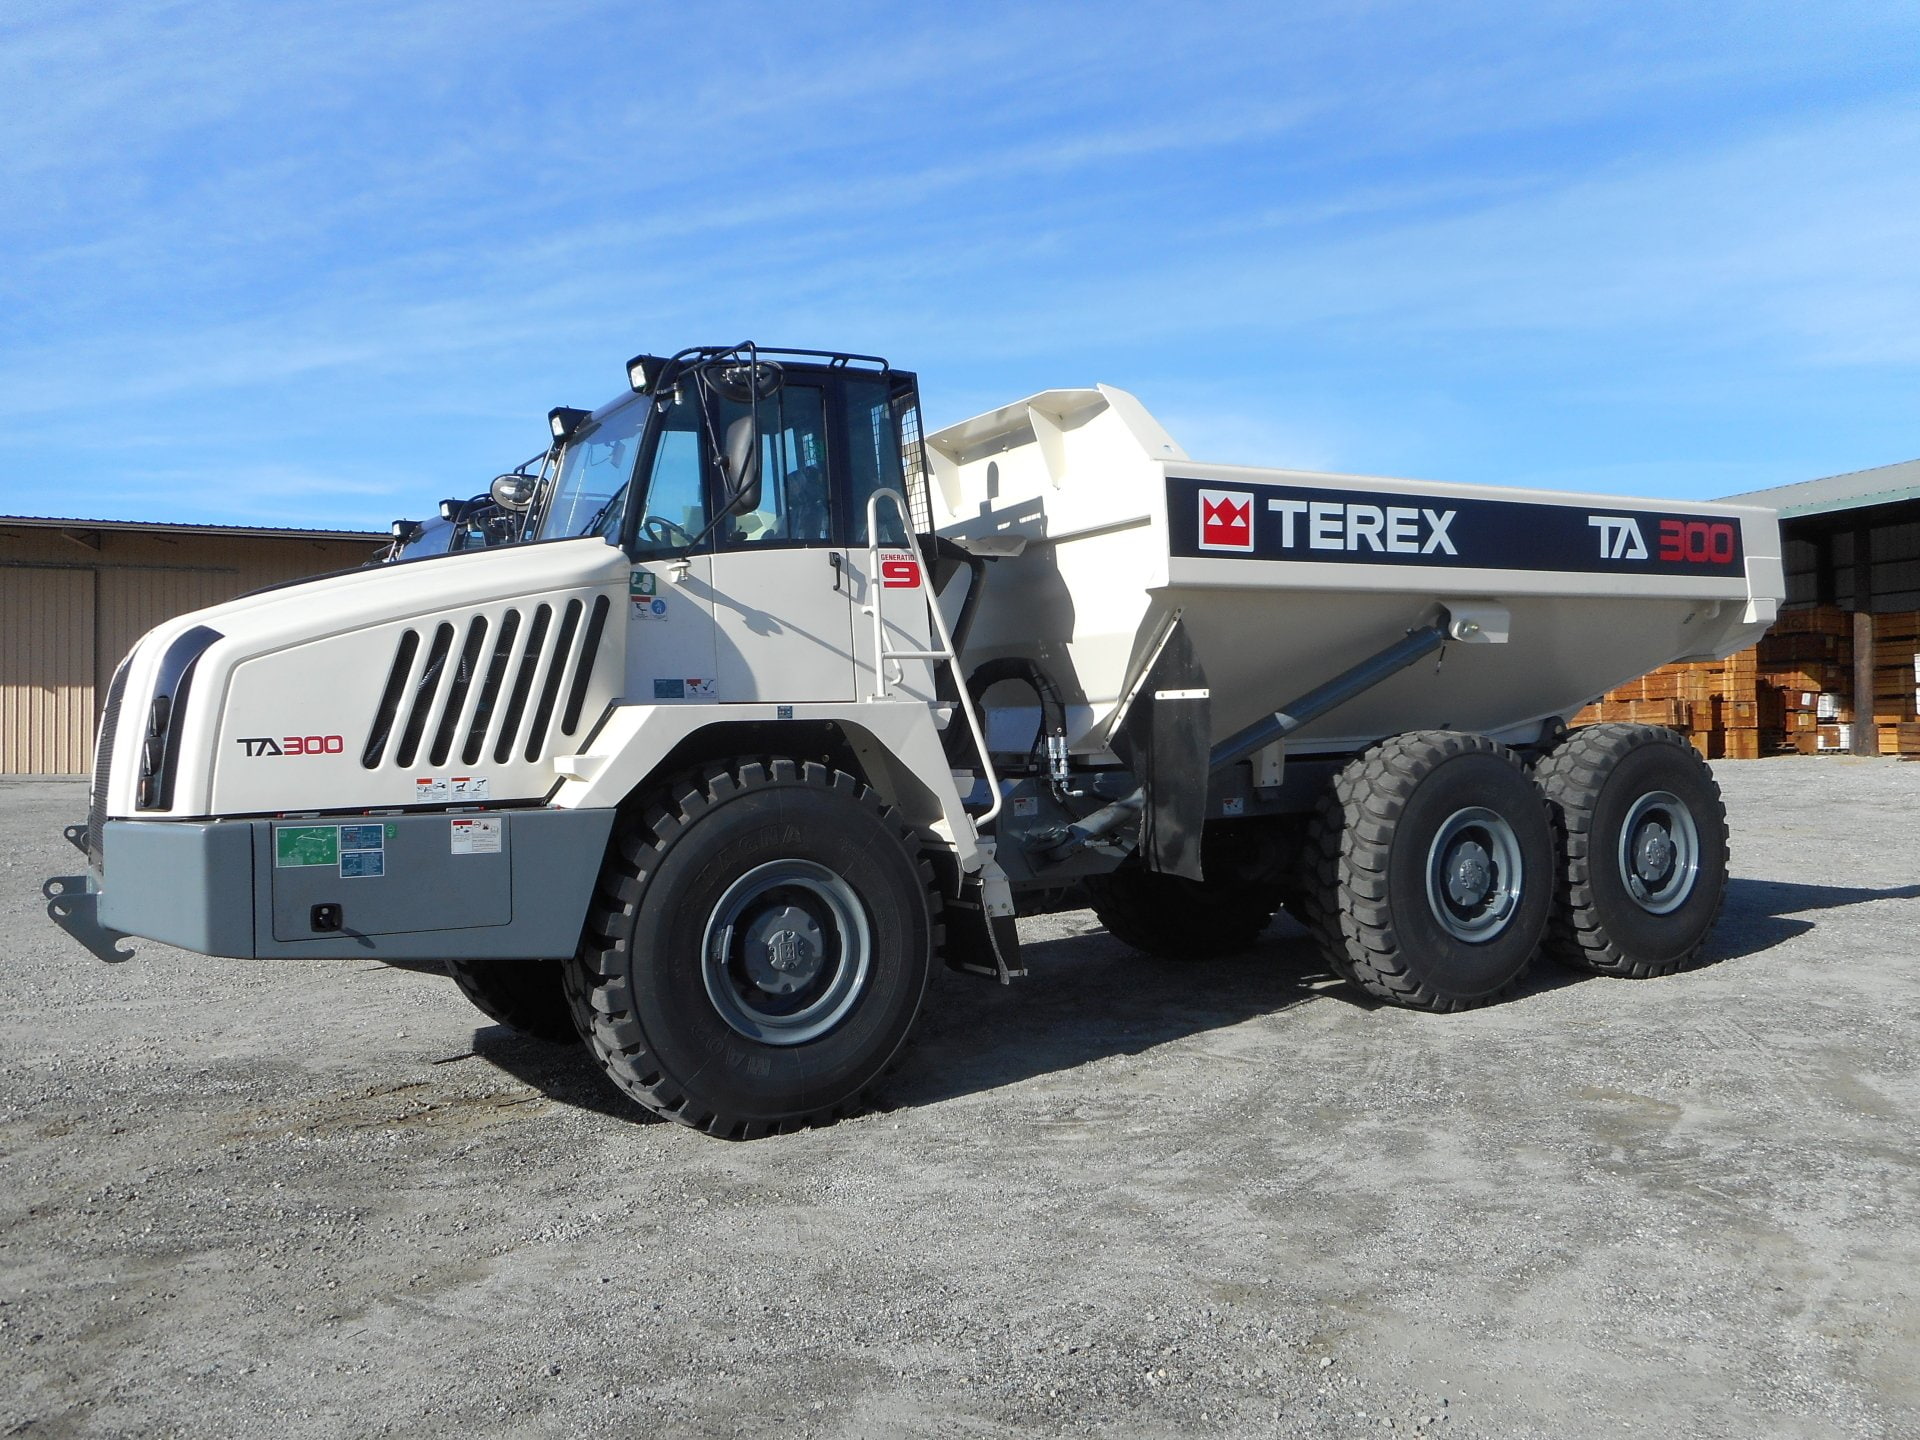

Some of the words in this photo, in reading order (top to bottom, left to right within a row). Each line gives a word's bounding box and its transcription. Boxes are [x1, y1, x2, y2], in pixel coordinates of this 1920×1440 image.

[1268, 499, 1458, 555] TEREX
[1588, 515, 1648, 559] TA
[1659, 519, 1734, 563] 300
[880, 553, 915, 561] GENERATIO
[881, 561, 921, 588] 9
[236, 735, 344, 757] TA300
